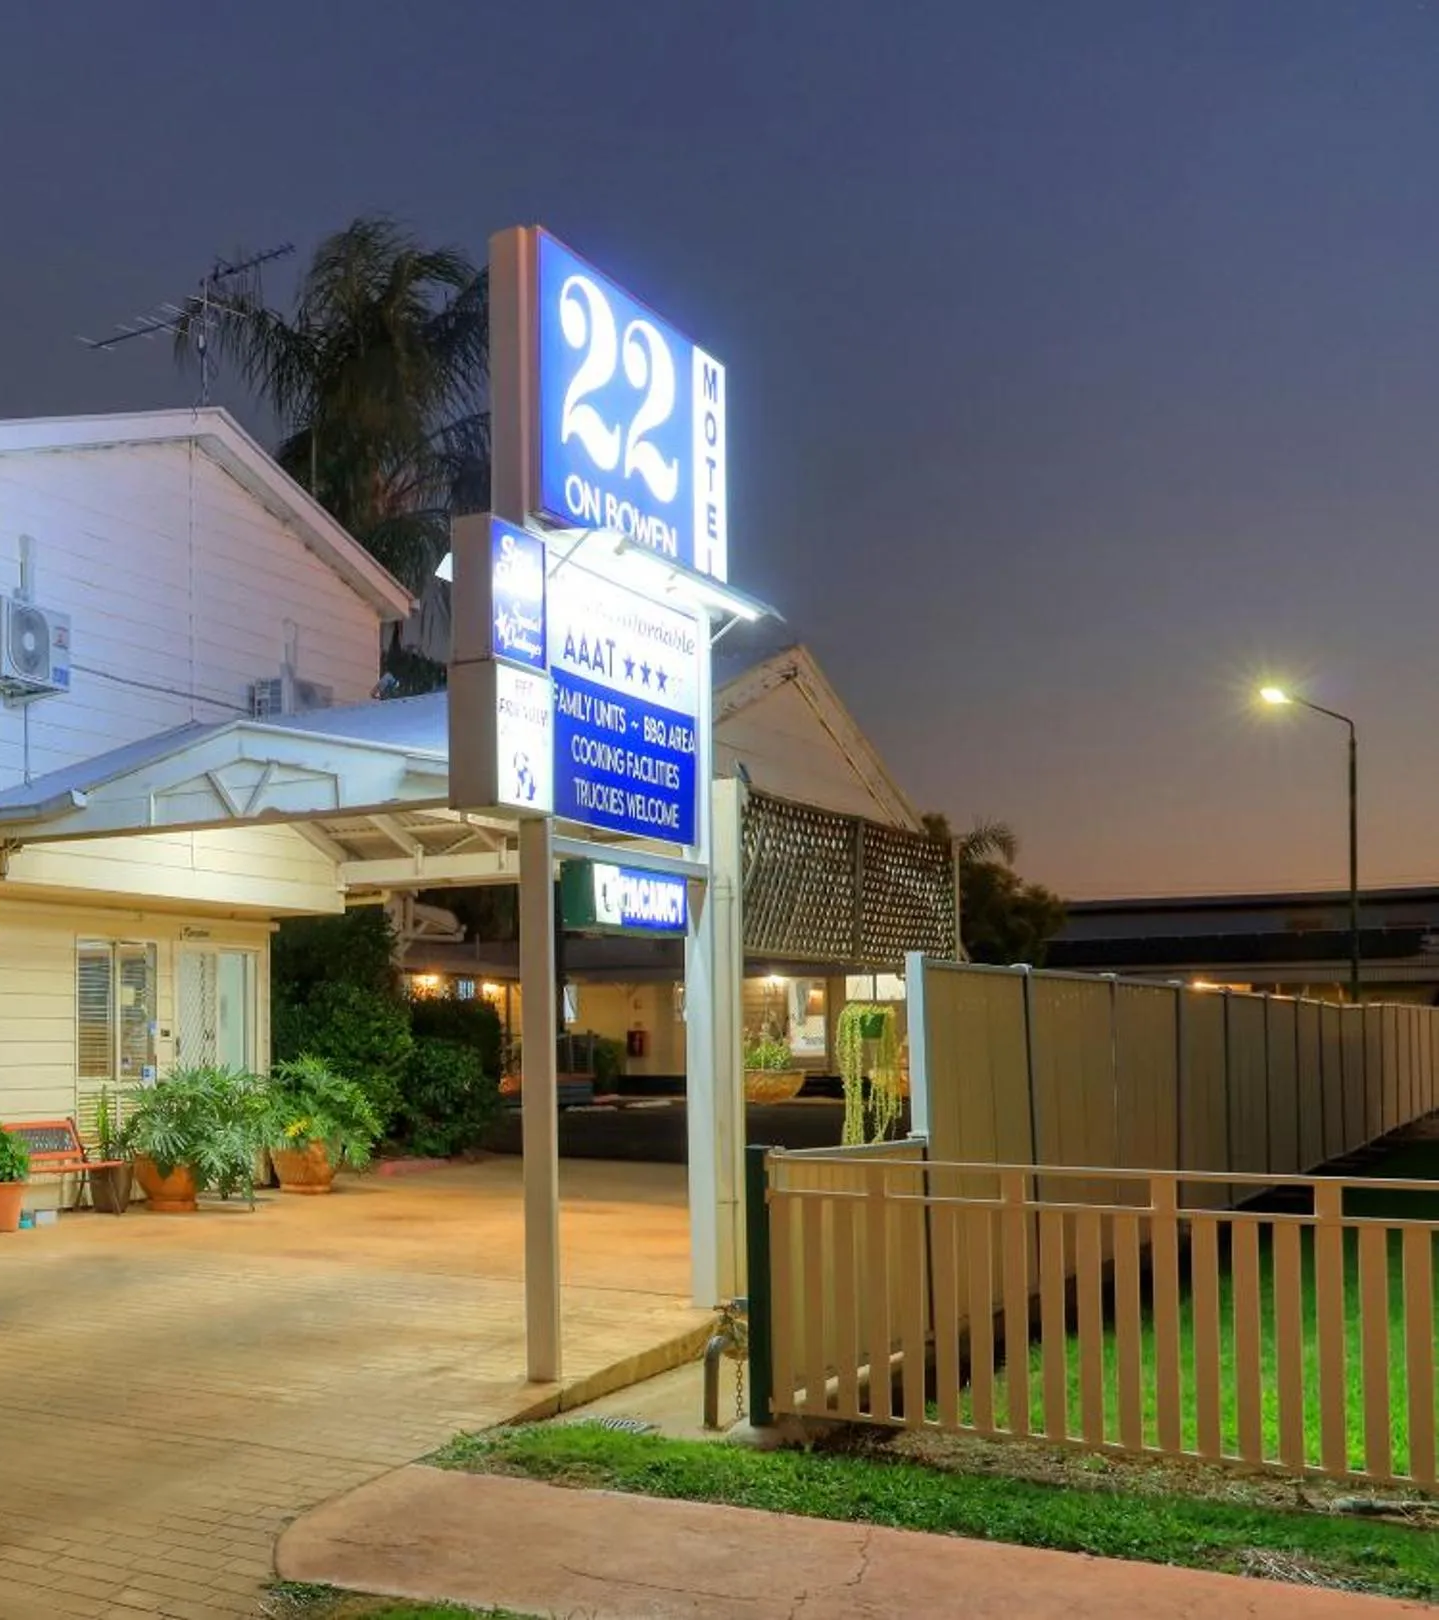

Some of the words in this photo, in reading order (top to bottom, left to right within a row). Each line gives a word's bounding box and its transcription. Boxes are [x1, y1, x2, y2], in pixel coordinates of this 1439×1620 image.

[560, 275, 679, 503] 22
[565, 474, 601, 526] ON
[563, 624, 616, 678] AAAT
[553, 682, 592, 722] FAMILY
[593, 698, 627, 734] UNITS
[643, 714, 667, 748] BBQ
[667, 724, 696, 753] AREA
[571, 733, 625, 775] COOKING
[626, 750, 681, 790] FACILITIES
[573, 776, 625, 817] TRUCKIES
[626, 791, 680, 829] WELCOME
